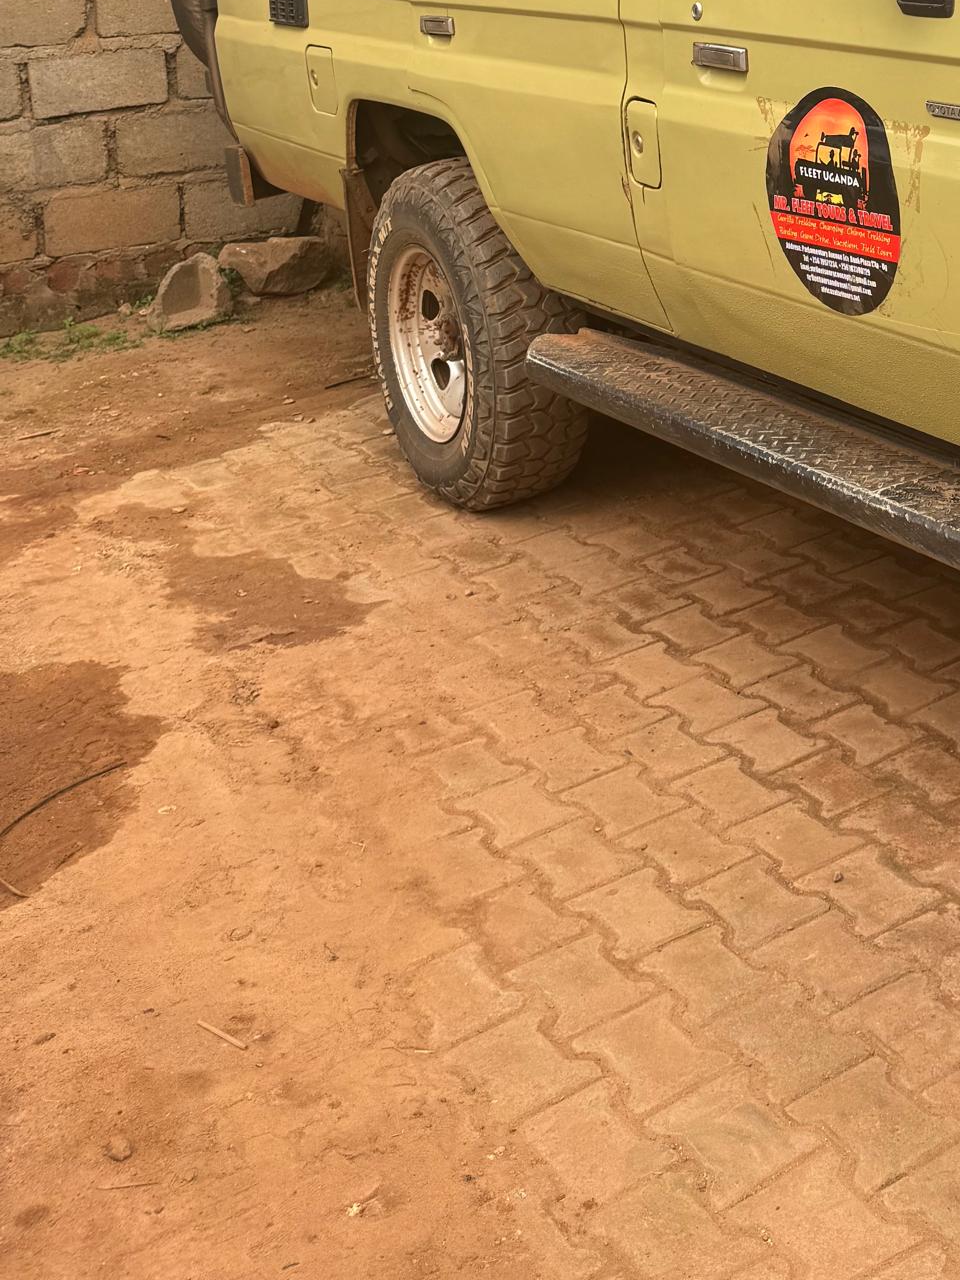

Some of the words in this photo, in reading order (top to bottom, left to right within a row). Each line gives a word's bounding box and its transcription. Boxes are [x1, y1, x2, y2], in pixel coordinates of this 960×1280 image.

[800, 166, 821, 180] FLEET
[823, 170, 860, 187] UGANDA
[773, 194, 790, 211] MR.
[791, 197, 815, 216] FLEET
[816, 201, 846, 222] TOURS
[857, 209, 894, 231] TRAVEL
